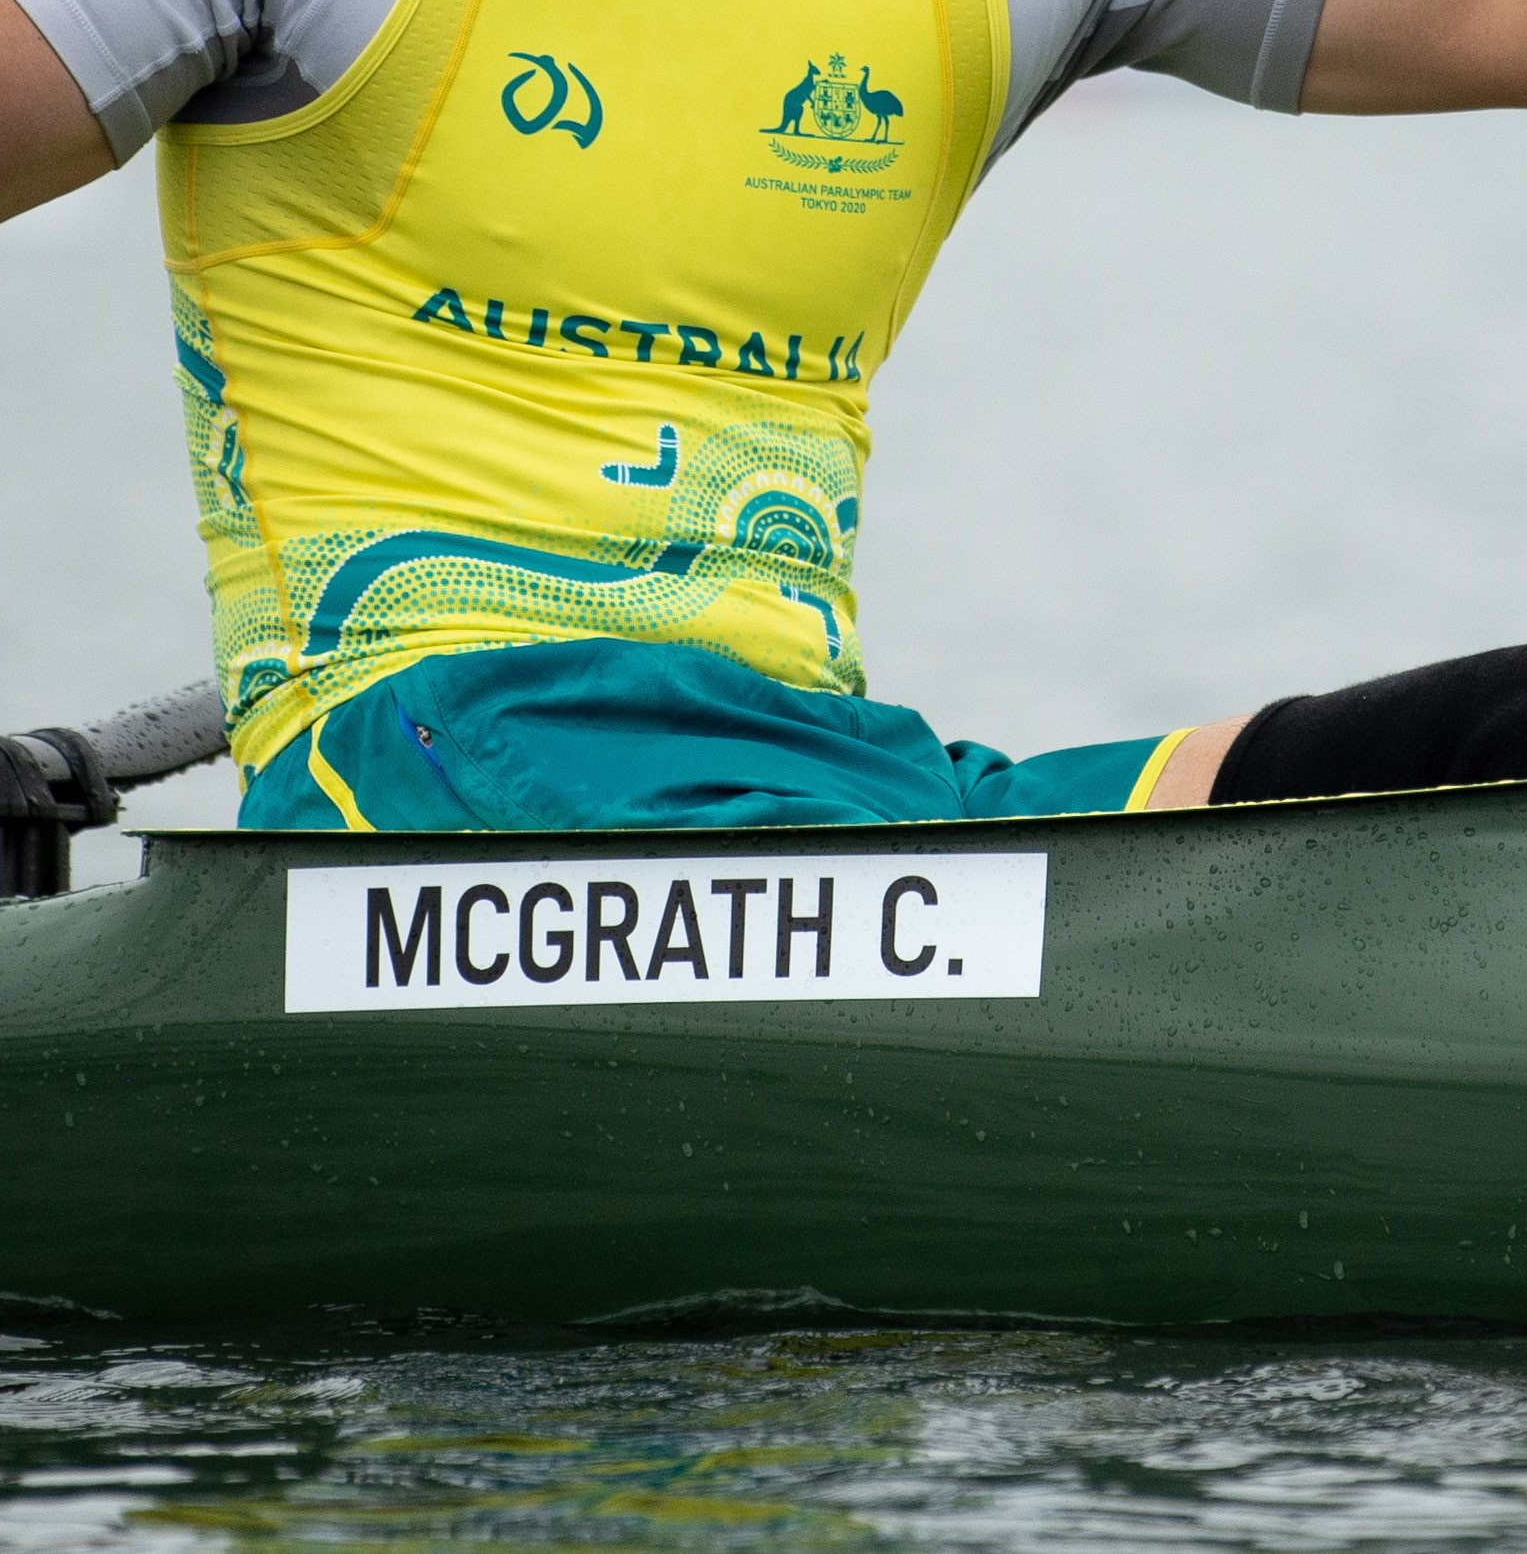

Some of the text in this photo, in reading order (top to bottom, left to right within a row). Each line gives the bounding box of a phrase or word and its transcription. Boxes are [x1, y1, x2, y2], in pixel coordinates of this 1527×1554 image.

[744, 176, 912, 201] AUSTRALIAN PARALYMPIC TEAM
[800, 196, 867, 214] TOKYO 2020
[365, 875, 964, 988] MCGRATH C.
